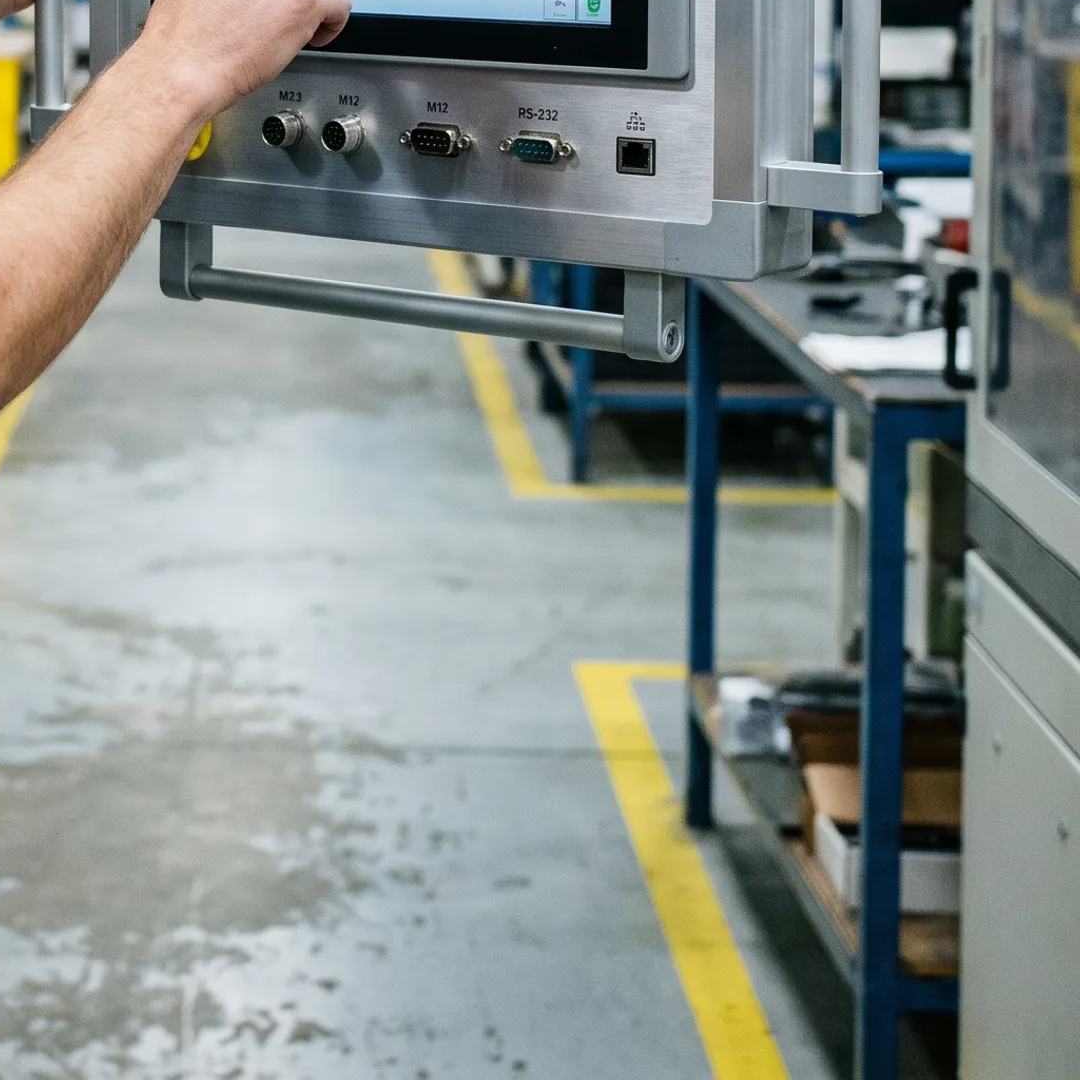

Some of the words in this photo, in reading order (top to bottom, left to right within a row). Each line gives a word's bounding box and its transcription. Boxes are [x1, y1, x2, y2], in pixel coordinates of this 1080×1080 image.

[279, 90, 302, 103] M23
[339, 94, 360, 107] M12
[426, 101, 449, 114] M12
[518, 107, 559, 122] RS-232
